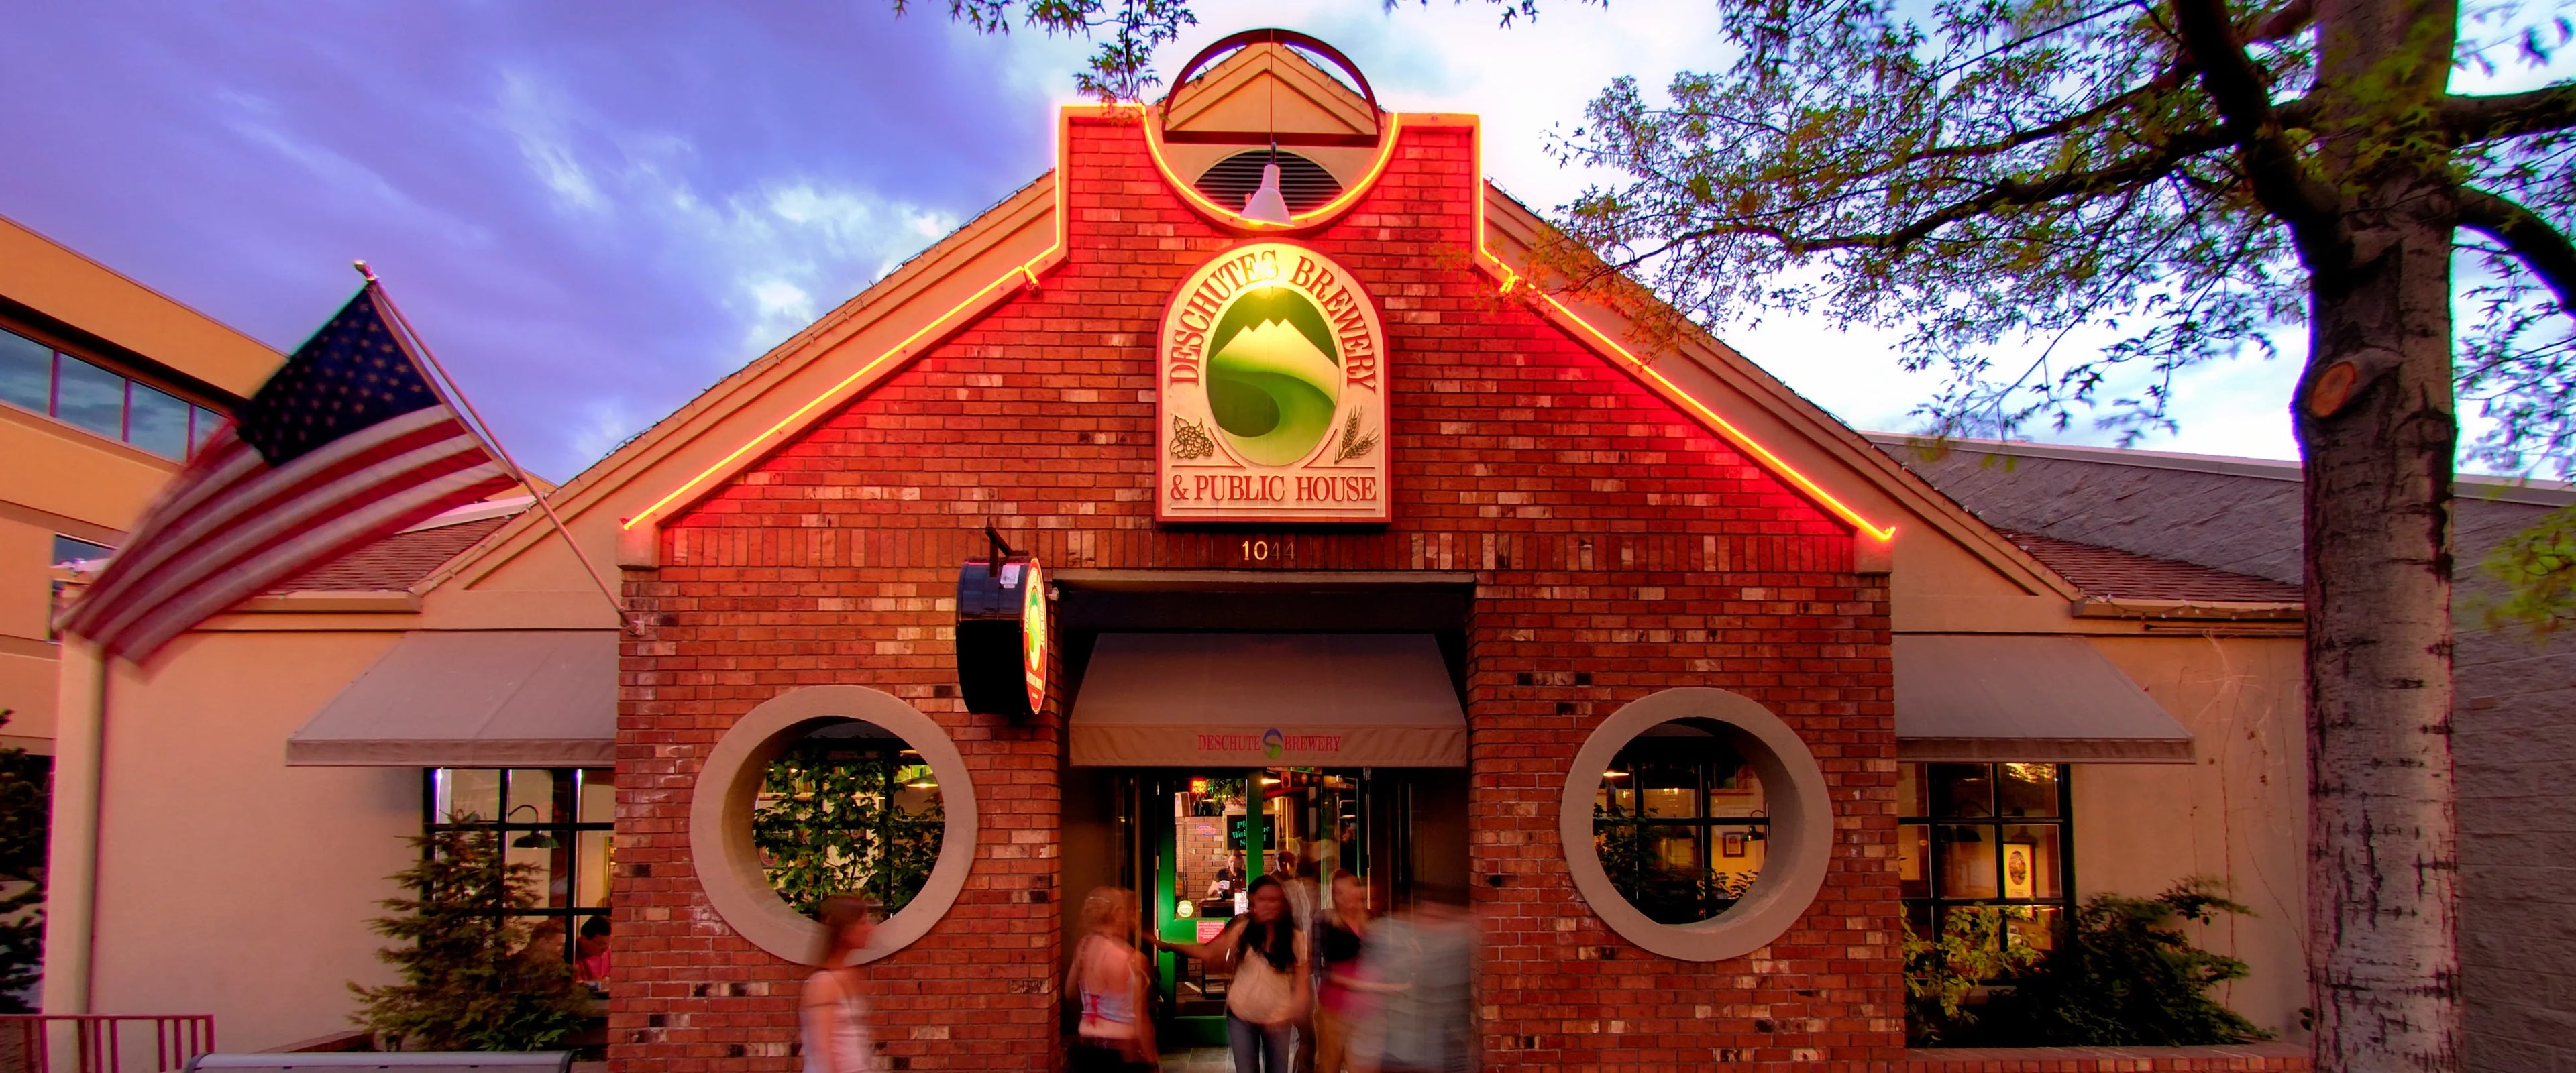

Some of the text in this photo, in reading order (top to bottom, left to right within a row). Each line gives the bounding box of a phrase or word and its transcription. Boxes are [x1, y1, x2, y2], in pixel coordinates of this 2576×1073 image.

[1170, 250, 1376, 394] DESCHUTES BREWERY
[1170, 474, 1377, 501] & PUBLIC HOUSE
[1242, 541, 1296, 561] 1044
[1283, 735, 1341, 752] BREWERY
